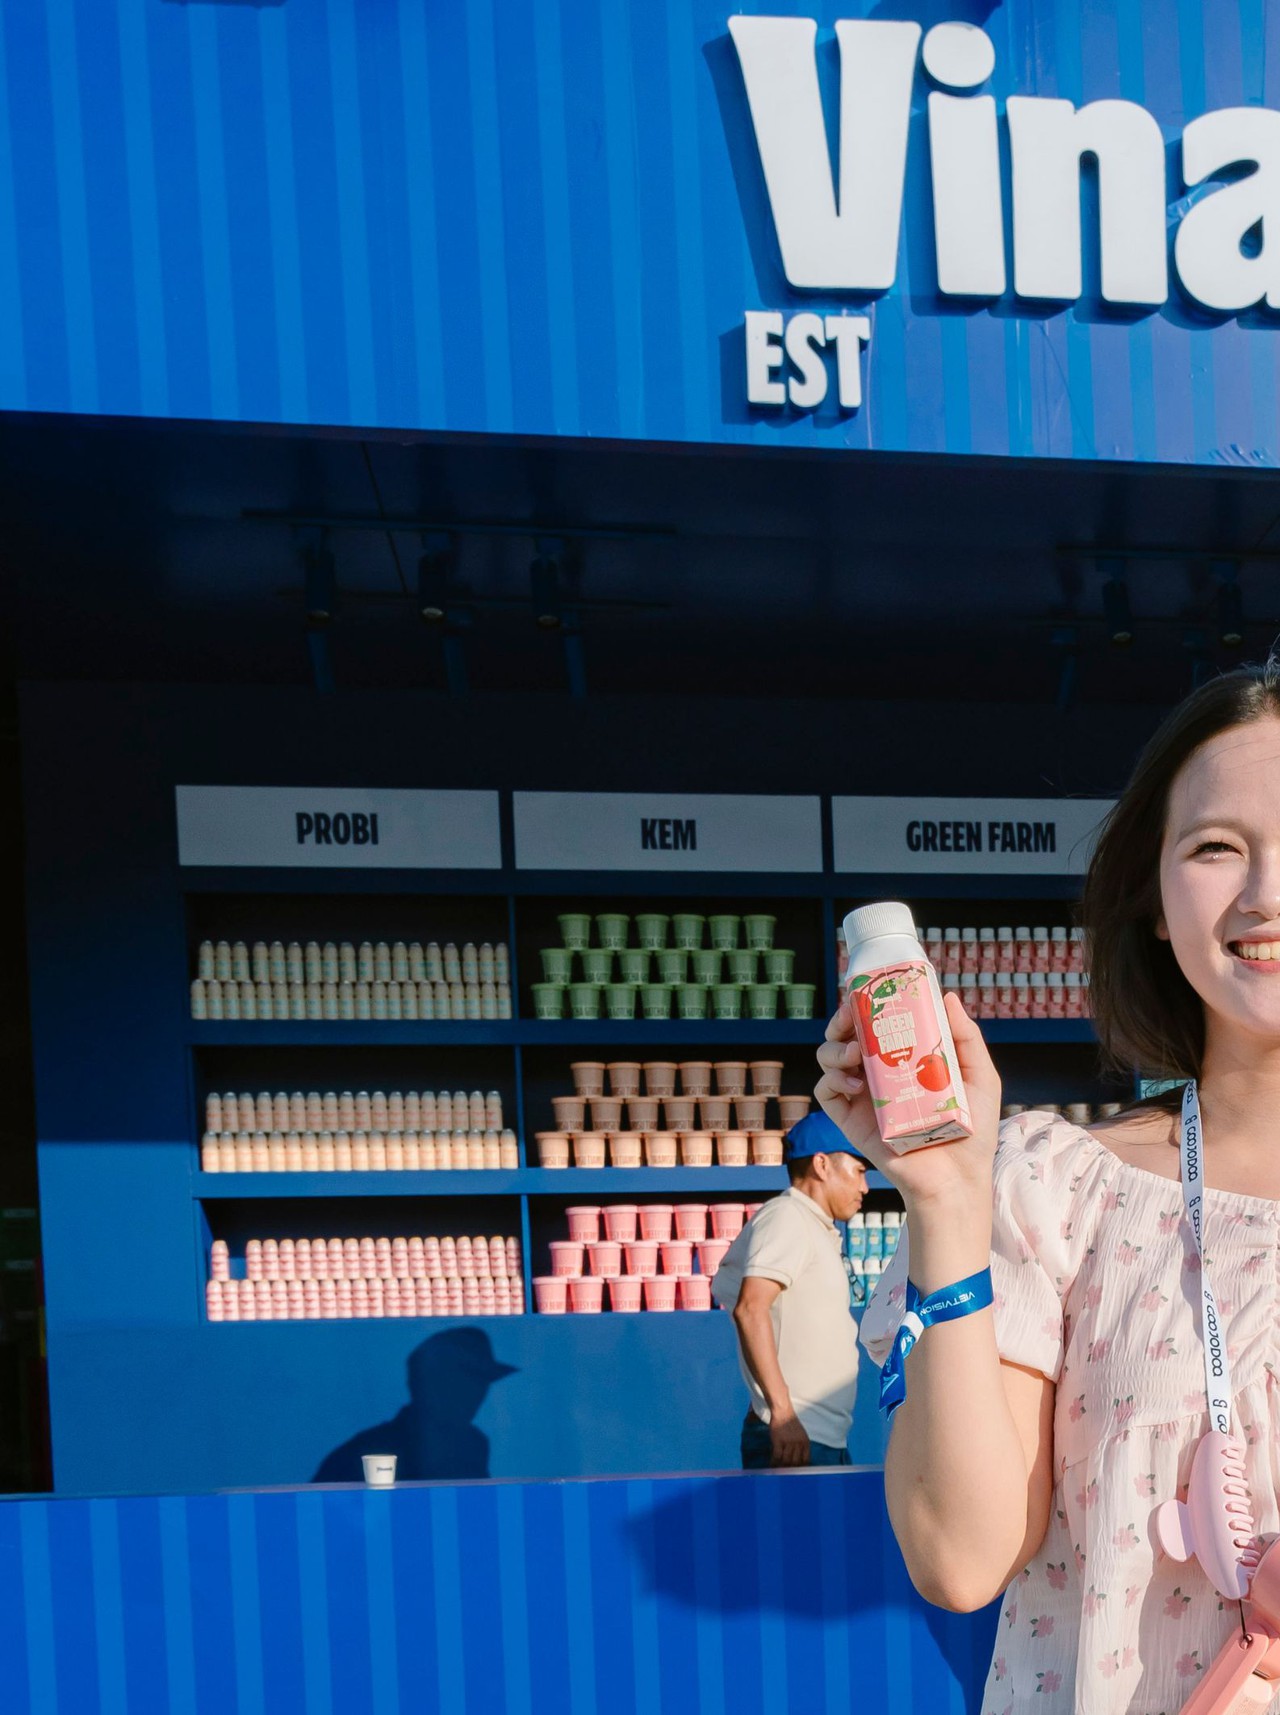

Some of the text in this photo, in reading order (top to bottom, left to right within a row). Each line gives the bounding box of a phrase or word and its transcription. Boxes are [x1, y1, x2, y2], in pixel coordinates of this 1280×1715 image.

[743, 309, 871, 408] EST
[295, 811, 380, 846] PROBI
[640, 818, 698, 851] KEM
[905, 819, 1058, 854] GREEN FARM
[872, 1010, 916, 1039] GREEN
[878, 1029, 917, 1054] FARM
[919, 1291, 976, 1317] VIETVISION
